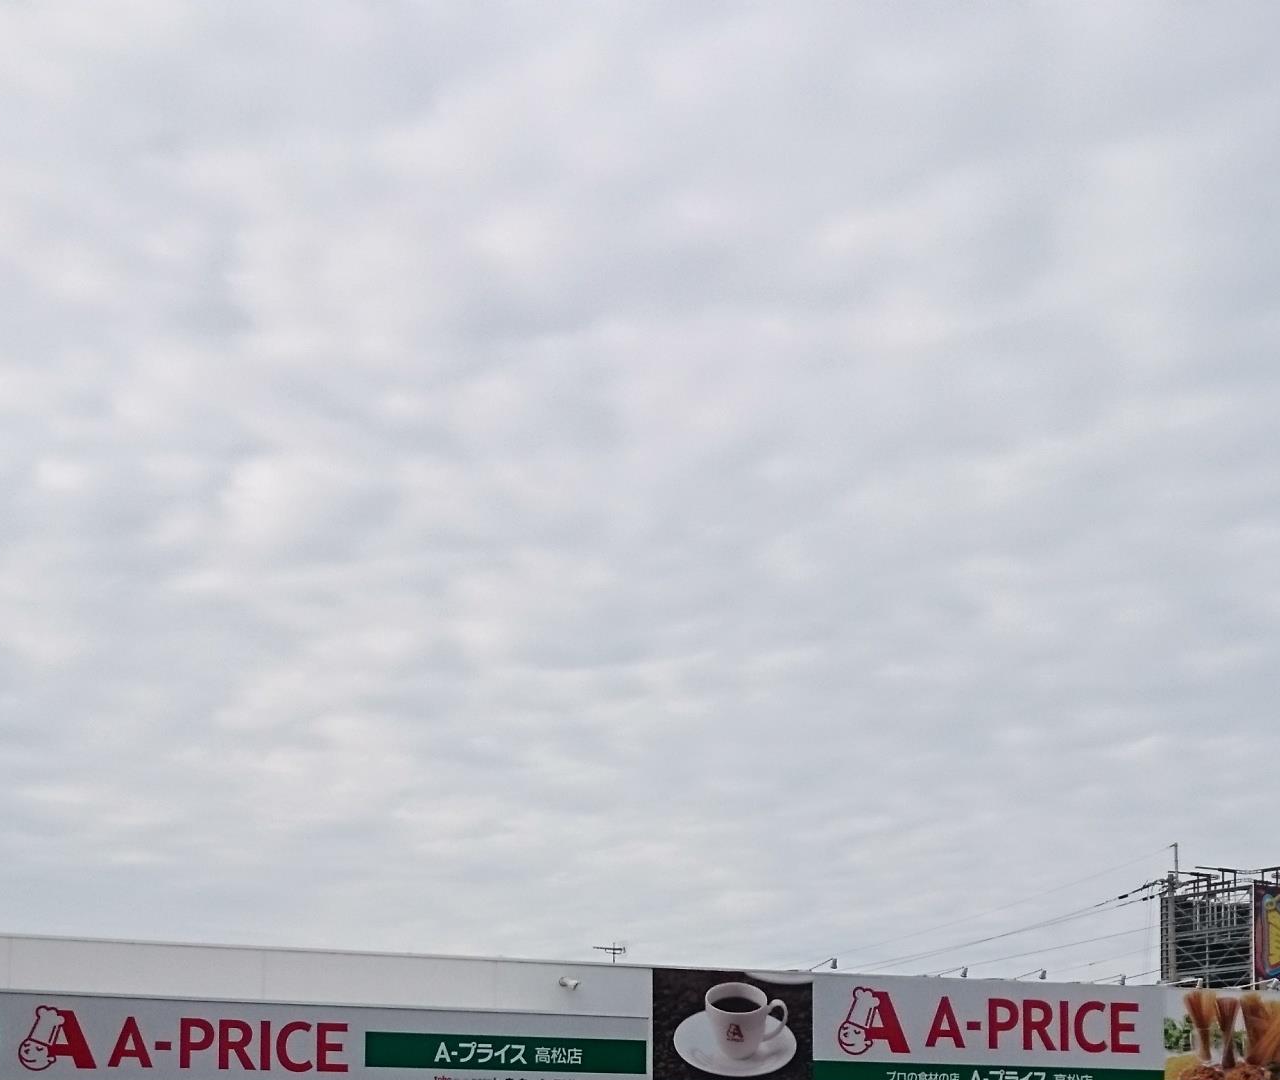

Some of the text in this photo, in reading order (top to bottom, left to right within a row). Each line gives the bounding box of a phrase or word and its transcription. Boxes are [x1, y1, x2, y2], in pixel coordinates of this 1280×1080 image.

[107, 1015, 349, 1074] A-PRICE
[434, 1041, 583, 1066] A-プライス 高松店
[925, 996, 1141, 1055] A-PRICE
